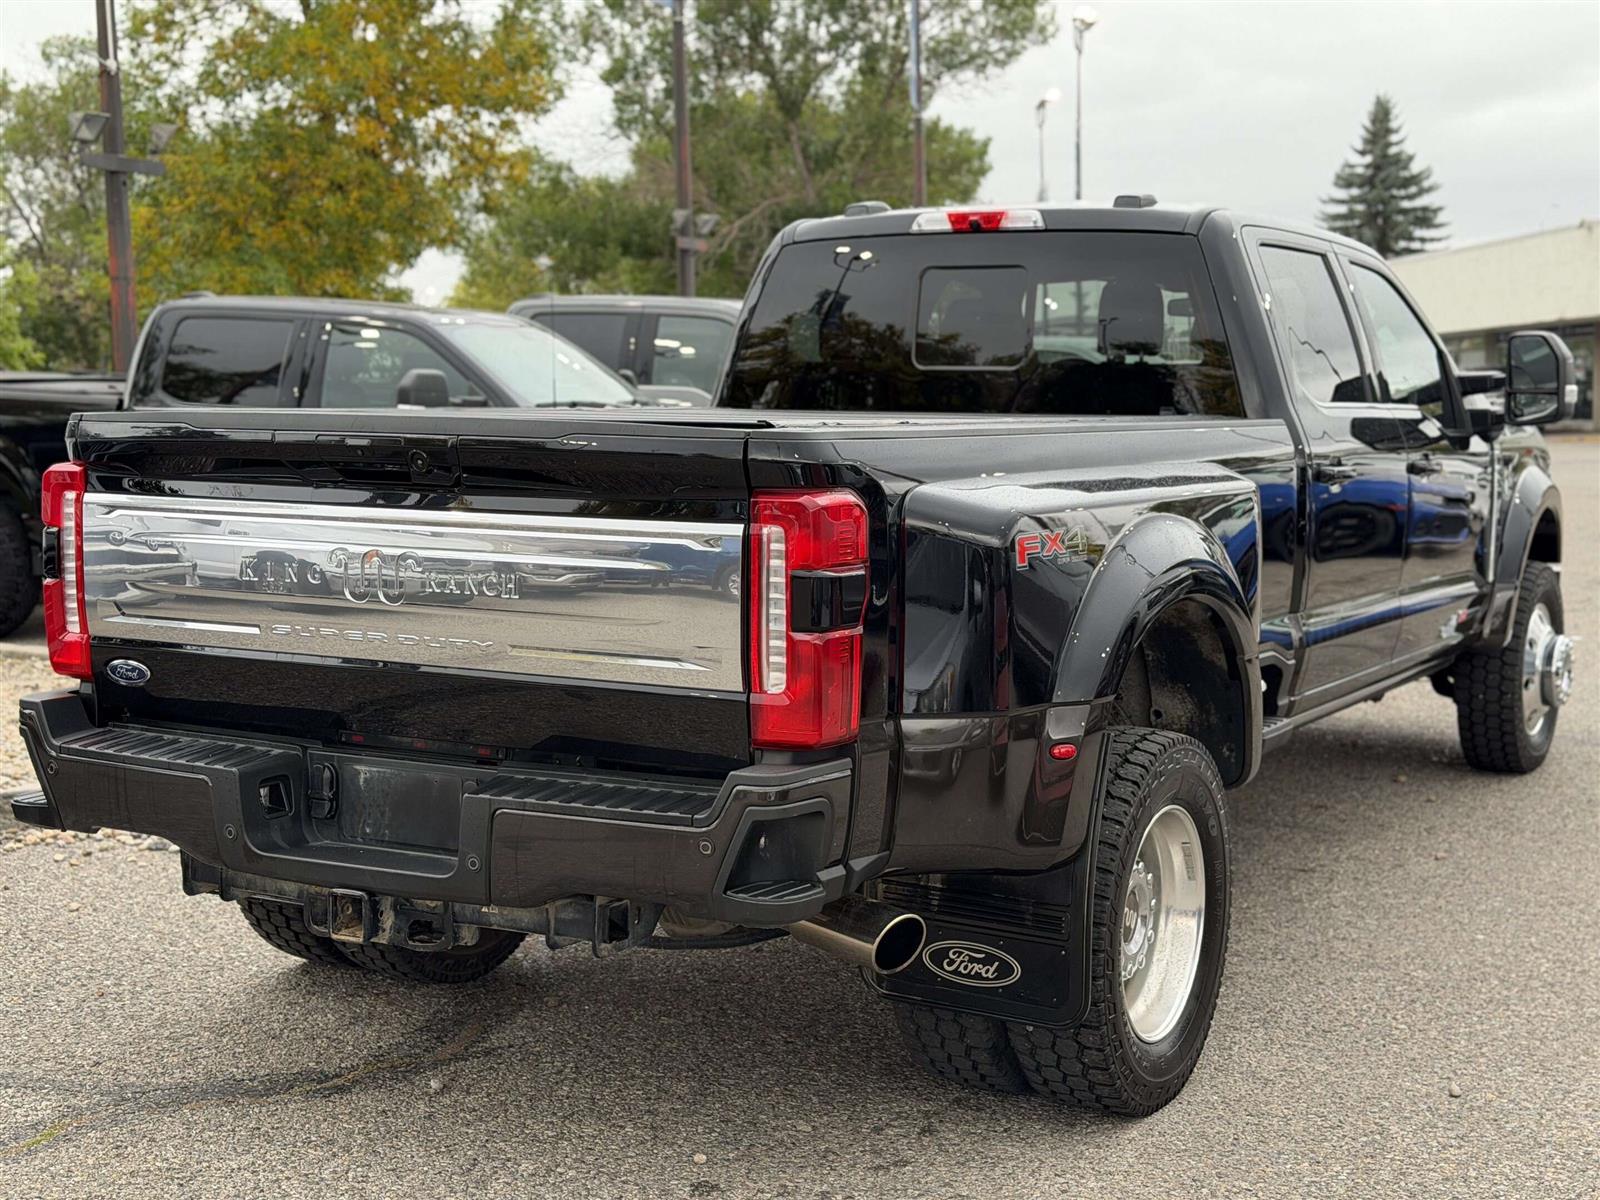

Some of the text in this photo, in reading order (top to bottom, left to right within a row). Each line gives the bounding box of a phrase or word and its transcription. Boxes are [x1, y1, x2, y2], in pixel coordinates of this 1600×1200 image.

[1015, 525, 1088, 570] FX4
[239, 555, 520, 599] KING RANCH
[271, 623, 494, 650] SUPER DUTY
[942, 947, 1000, 979] Ford
